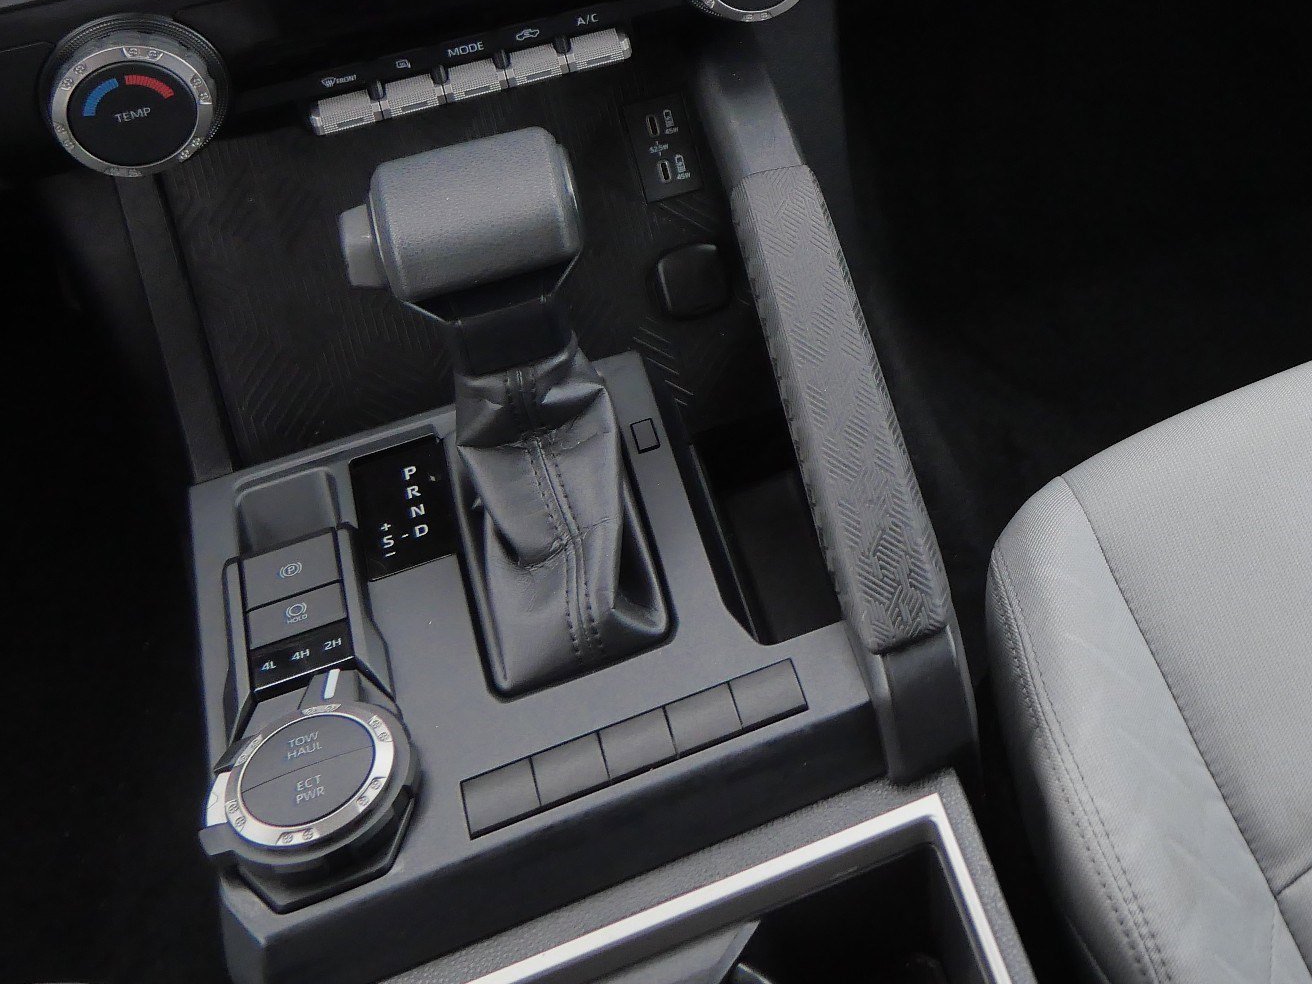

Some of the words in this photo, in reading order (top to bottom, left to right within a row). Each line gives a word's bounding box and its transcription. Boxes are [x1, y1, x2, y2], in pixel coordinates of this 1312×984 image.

[575, 13, 599, 26] A/C
[447, 41, 485, 57] MODE
[114, 107, 151, 123] TEMP
[402, 465, 417, 480] P
[406, 485, 421, 500] R
[410, 503, 426, 518] N
[414, 523, 429, 538] D
[382, 534, 395, 549] S
[286, 614, 308, 624] HOLD
[262, 661, 277, 671] 4L
[291, 648, 310, 661] 4H
[324, 637, 342, 651] 2H
[288, 730, 320, 749] TOW
[287, 743, 323, 761] HAUL
[296, 774, 322, 792] ECT
[296, 786, 325, 804] PWR
